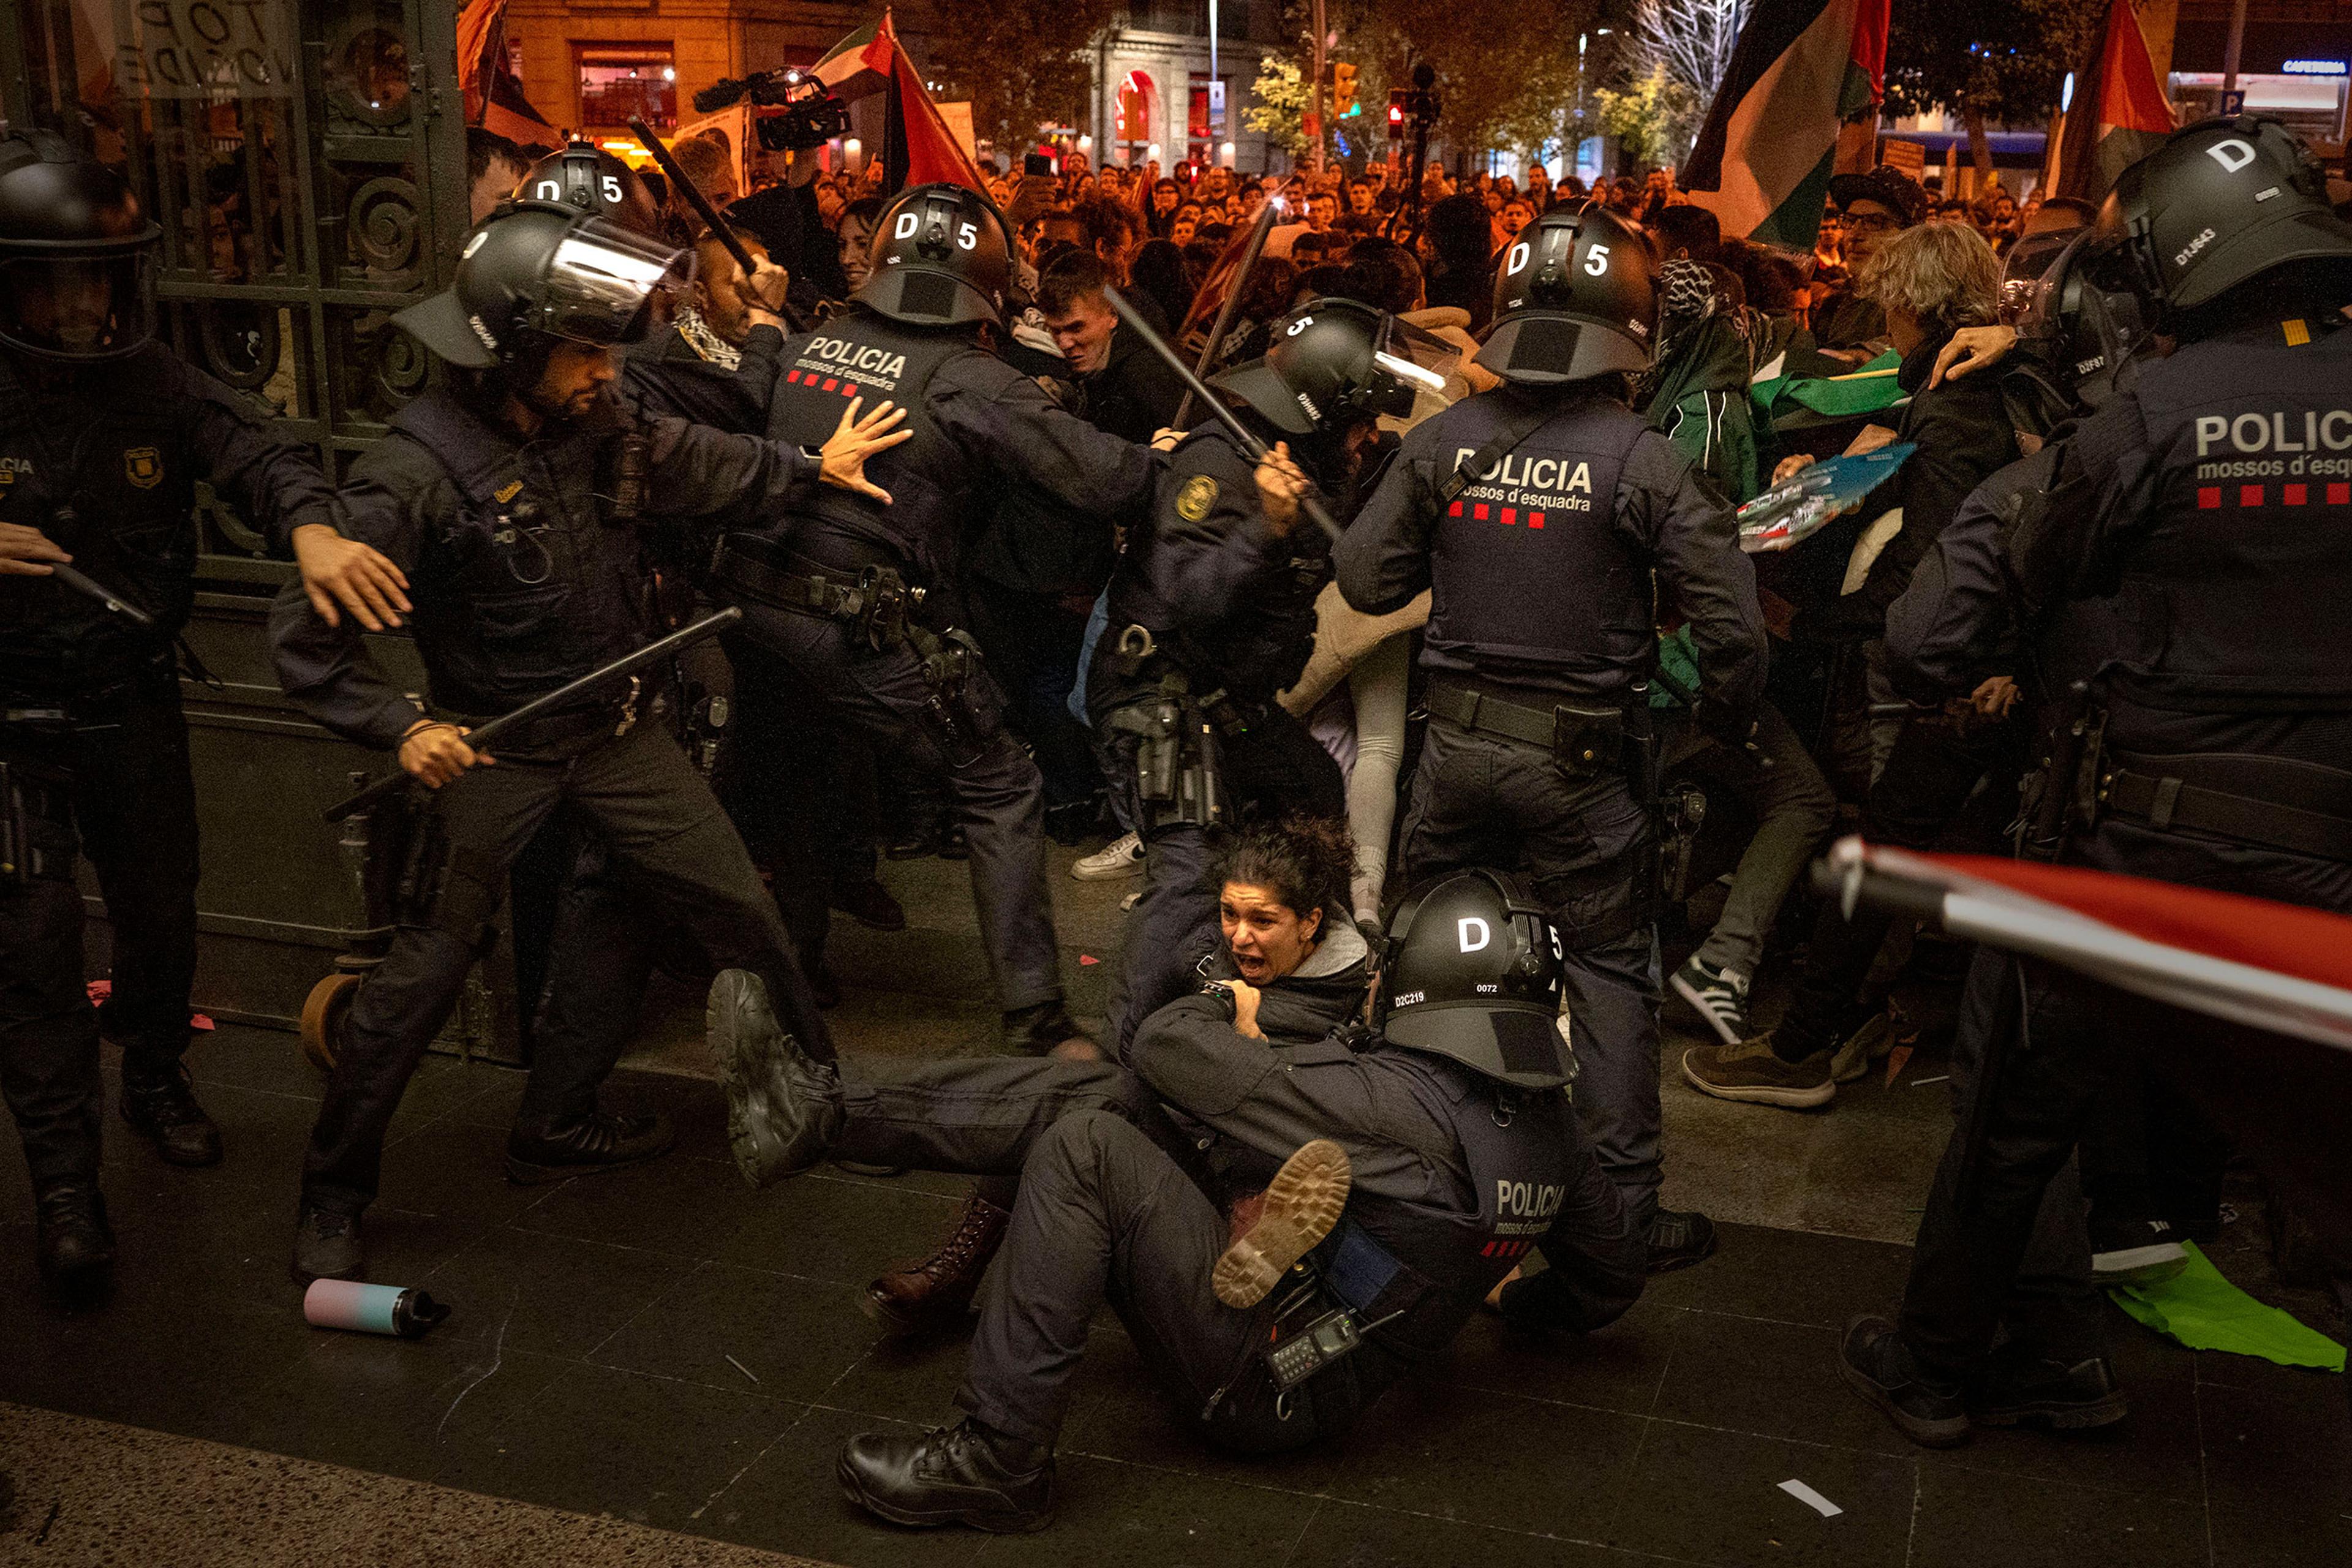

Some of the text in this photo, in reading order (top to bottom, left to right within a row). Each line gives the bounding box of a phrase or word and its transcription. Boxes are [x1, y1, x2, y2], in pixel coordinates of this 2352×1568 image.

[2225, 93, 2239, 113] P
[2206, 139, 2256, 173] D
[602, 176, 623, 203] 5
[895, 213, 977, 250] D 5
[1507, 242, 1610, 276] D 5
[1287, 316, 1314, 336] 5
[802, 337, 907, 379] POLICIA
[2197, 460, 2285, 480] mossos
[1460, 485, 1504, 501] ossos
[1458, 918, 1562, 960] D 5
[1395, 991, 1425, 1008] D2C219
[1477, 984, 1498, 993] 0072
